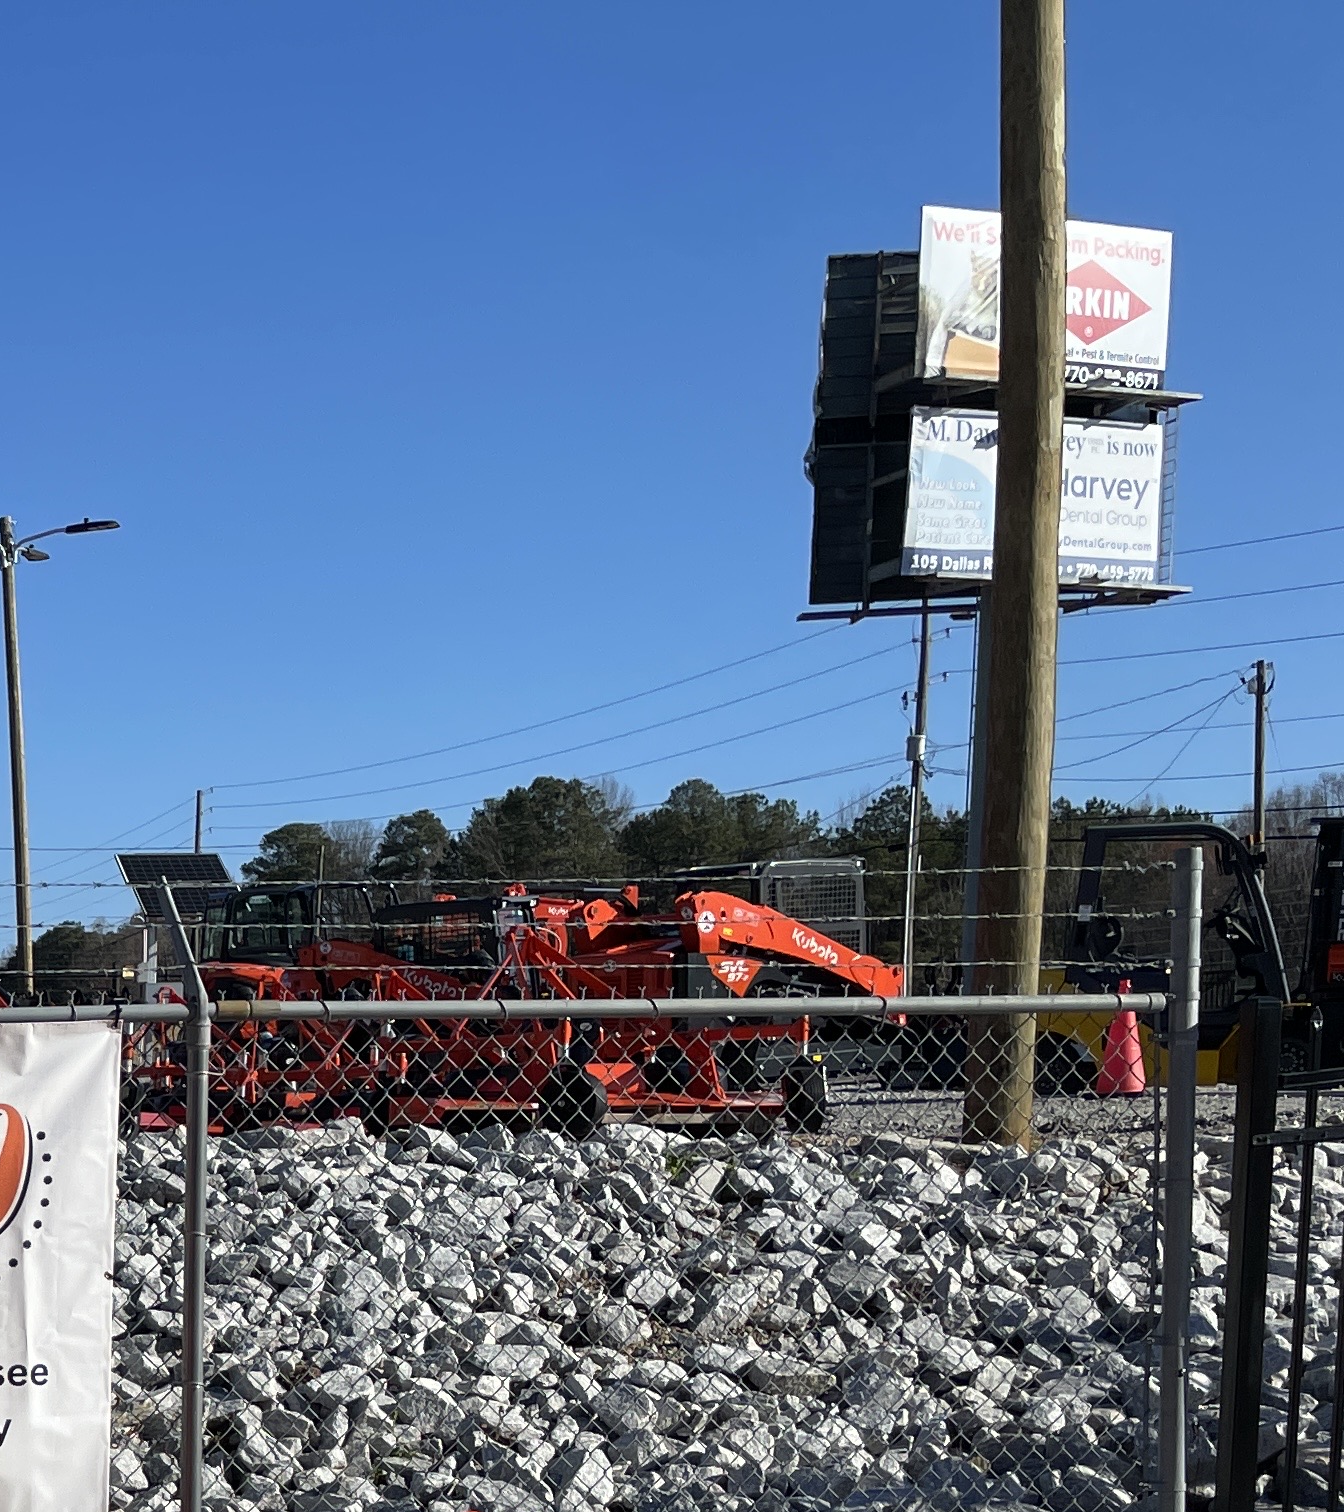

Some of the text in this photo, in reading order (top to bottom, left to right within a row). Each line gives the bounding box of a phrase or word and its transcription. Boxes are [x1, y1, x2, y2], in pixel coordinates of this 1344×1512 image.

[1095, 237, 1165, 267] Packing.
[1066, 285, 1131, 320] RKIN
[1107, 435, 1119, 455] is
[1123, 442, 1158, 457] now
[1106, 510, 1148, 530] Group
[911, 554, 938, 570] 105
[941, 556, 981, 571] Dallas
[792, 927, 839, 965] Kubota
[403, 968, 457, 998] Kubota
